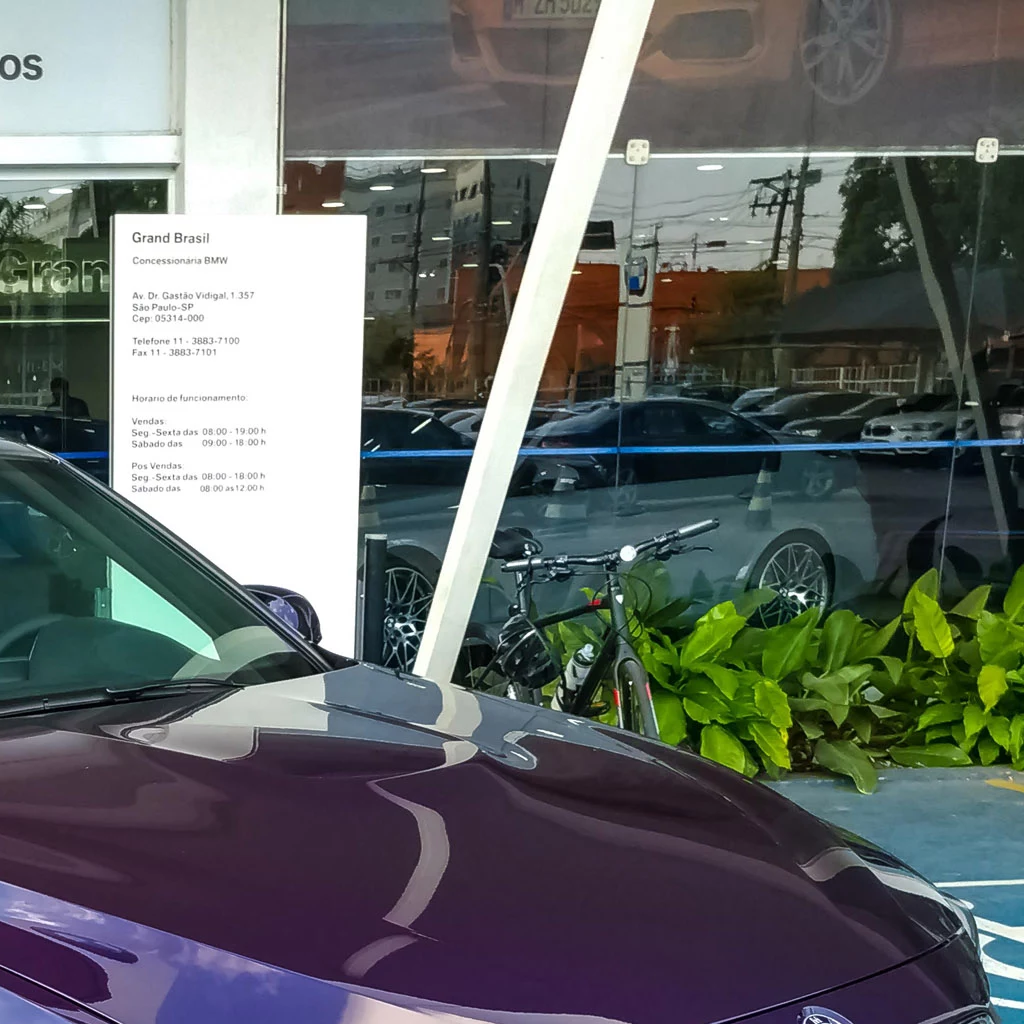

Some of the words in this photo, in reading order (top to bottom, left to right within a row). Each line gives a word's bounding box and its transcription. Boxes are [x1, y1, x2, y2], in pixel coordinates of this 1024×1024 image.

[132, 231, 170, 243] Grand
[174, 232, 210, 244] Brasil
[204, 256, 228, 265] BMW
[132, 291, 146, 300] Av.
[148, 291, 160, 300] Dr.
[162, 291, 193, 300] Gastão
[195, 291, 229, 302] Vidigal,
[231, 291, 255, 299] 1.357
[132, 303, 150, 311] São
[151, 303, 194, 311] Paulo-SP
[132, 314, 153, 324] Cep:
[155, 314, 205, 322] 05314-000
[132, 337, 171, 345] Telefone
[173, 337, 183, 345] 11
[192, 336, 240, 345] 3883-7100
[132, 348, 147, 356] Fax
[150, 348, 160, 356] 11
[168, 348, 217, 356] 3883-7101
[167, 394, 178, 402] de
[183, 428, 198, 436] das
[235, 427, 259, 435] 19:00
[261, 427, 266, 435] h
[202, 439, 227, 447] 09:00
[182, 473, 198, 481] das
[235, 472, 259, 480] 18:00
[260, 472, 265, 480] h
[259, 484, 265, 492] h
